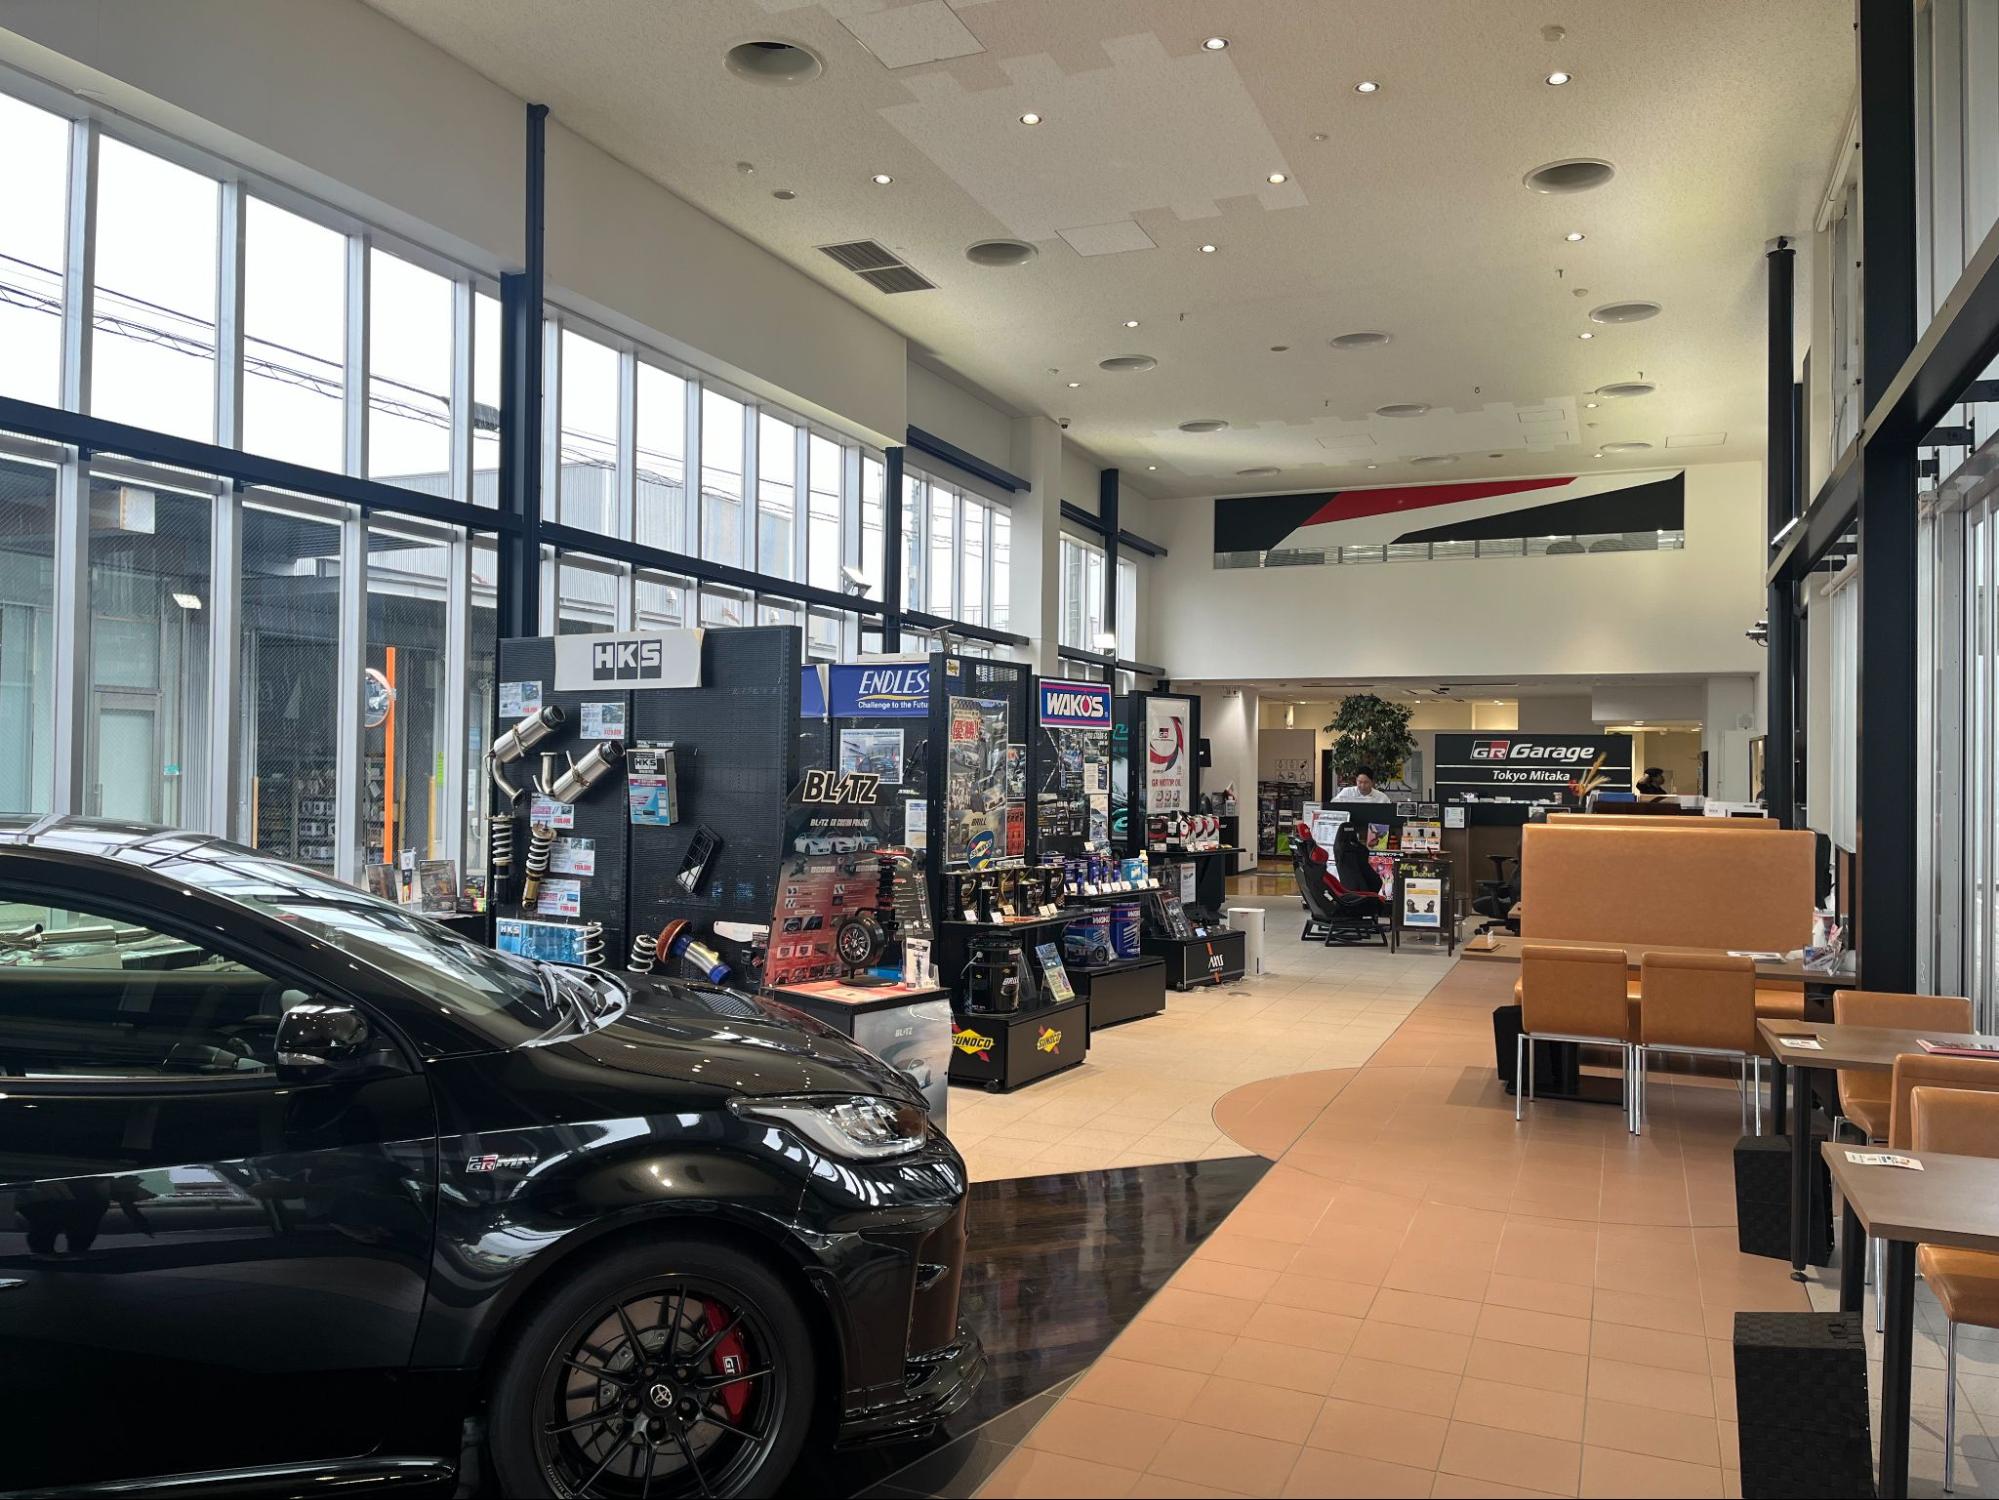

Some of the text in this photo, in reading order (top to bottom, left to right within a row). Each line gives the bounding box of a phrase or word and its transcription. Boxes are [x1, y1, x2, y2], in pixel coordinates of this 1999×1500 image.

[594, 642, 662, 670] HKS
[858, 701, 890, 711] Challenge
[901, 701, 912, 709] the
[1047, 692, 1104, 718] WAKO'S
[1471, 743, 1595, 763] GR Garage
[635, 758, 657, 768] HKS
[1493, 770, 1571, 782] Tokyo Mitaka
[802, 770, 880, 804] BLITZ
[501, 924, 520, 934] HKS
[952, 1035, 992, 1049] SUNOCO
